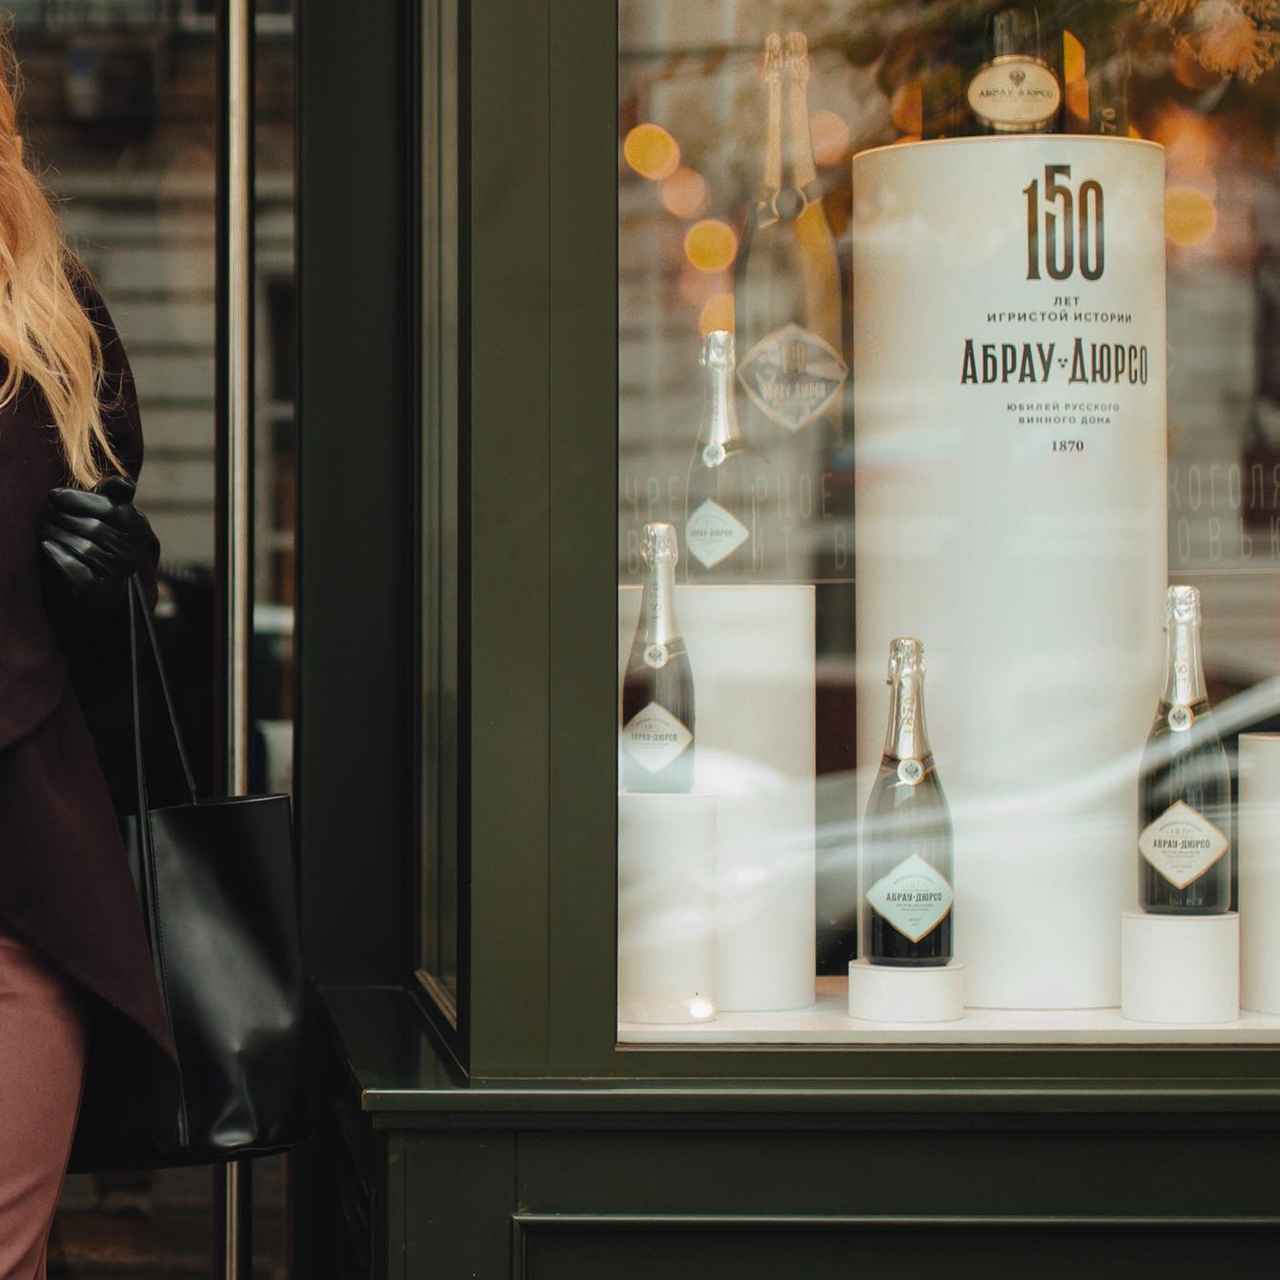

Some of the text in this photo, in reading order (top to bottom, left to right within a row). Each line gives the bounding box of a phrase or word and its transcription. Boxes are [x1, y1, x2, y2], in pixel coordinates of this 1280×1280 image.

[1022, 164, 1105, 281] 150
[1054, 296, 1081, 307] ЛЕТ
[986, 310, 1133, 323] ИГРИСТОЙ ИСТОРИИ
[1006, 401, 1120, 412] ЮБИЛЕЙ РУССКОГО
[1018, 416, 1111, 425] ВИННОГО ДОМА
[1051, 440, 1084, 452] 1870
